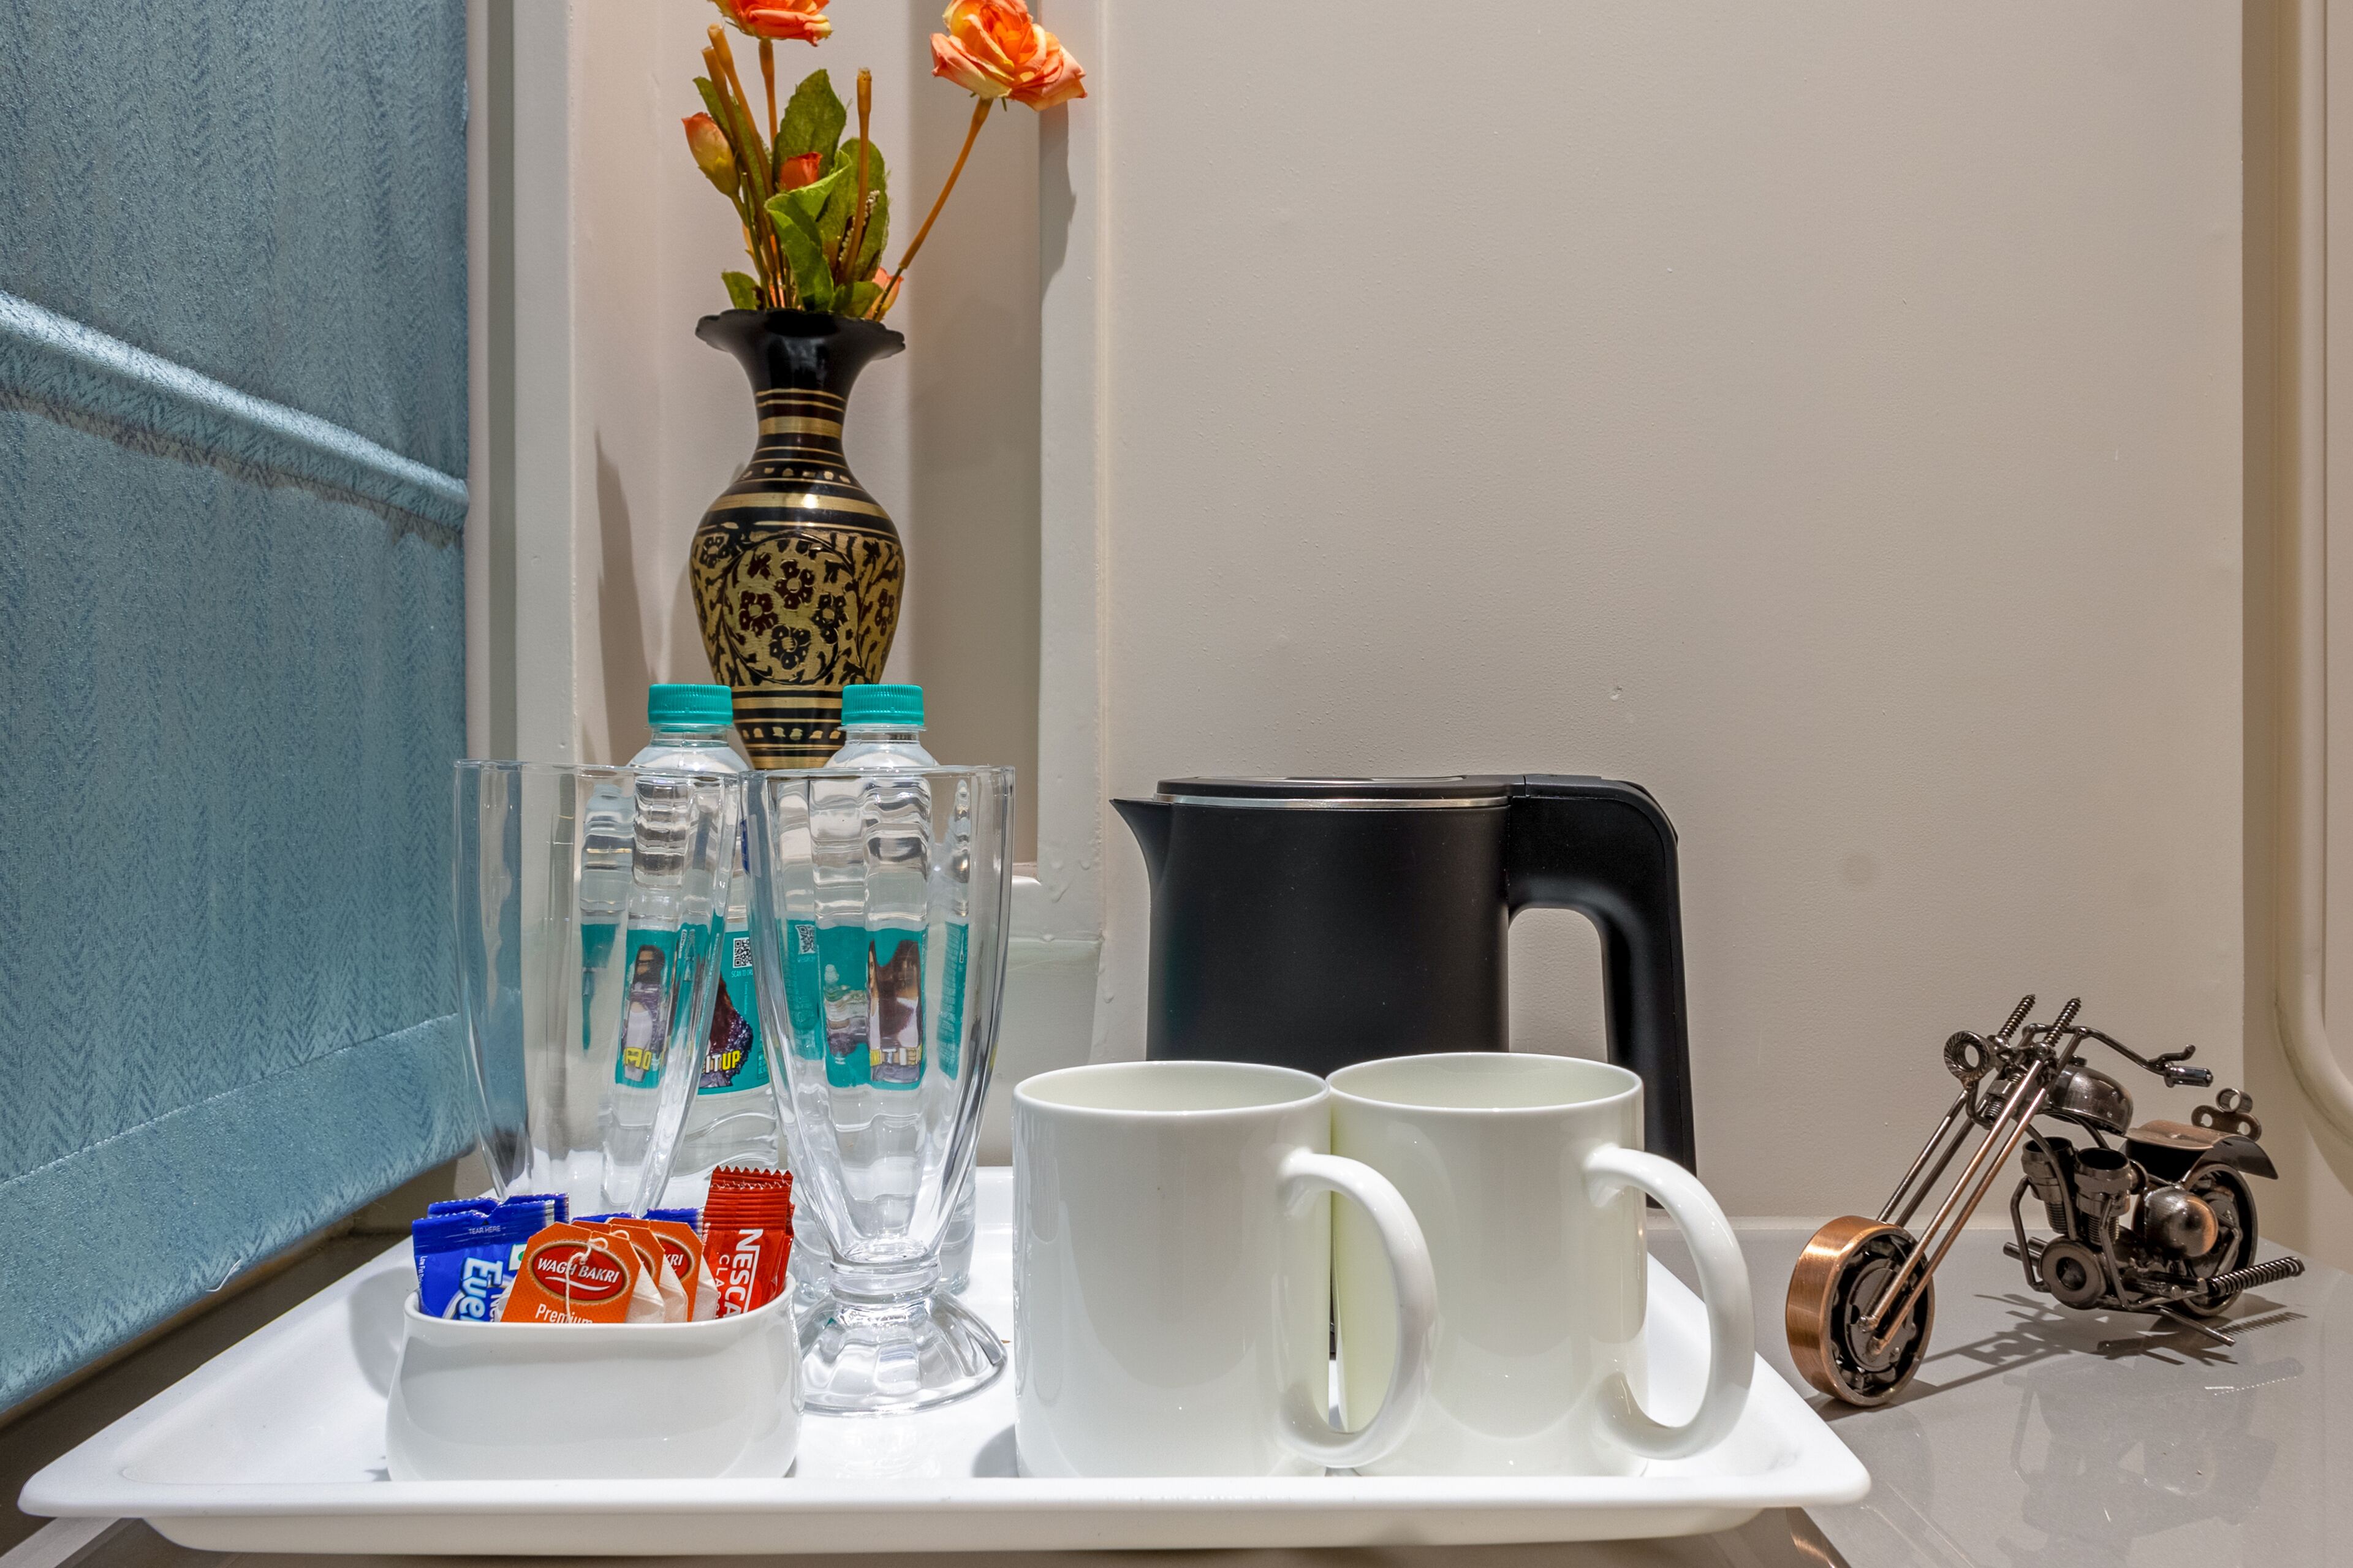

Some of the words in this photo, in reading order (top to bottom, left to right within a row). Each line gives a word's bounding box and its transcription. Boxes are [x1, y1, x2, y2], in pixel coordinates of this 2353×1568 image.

[722, 1050, 740, 1071] UP
[468, 1226, 484, 1235] TEAR
[419, 1255, 428, 1265] Low
[537, 1257, 578, 1276] WAGH
[578, 1264, 621, 1284] BAKRI
